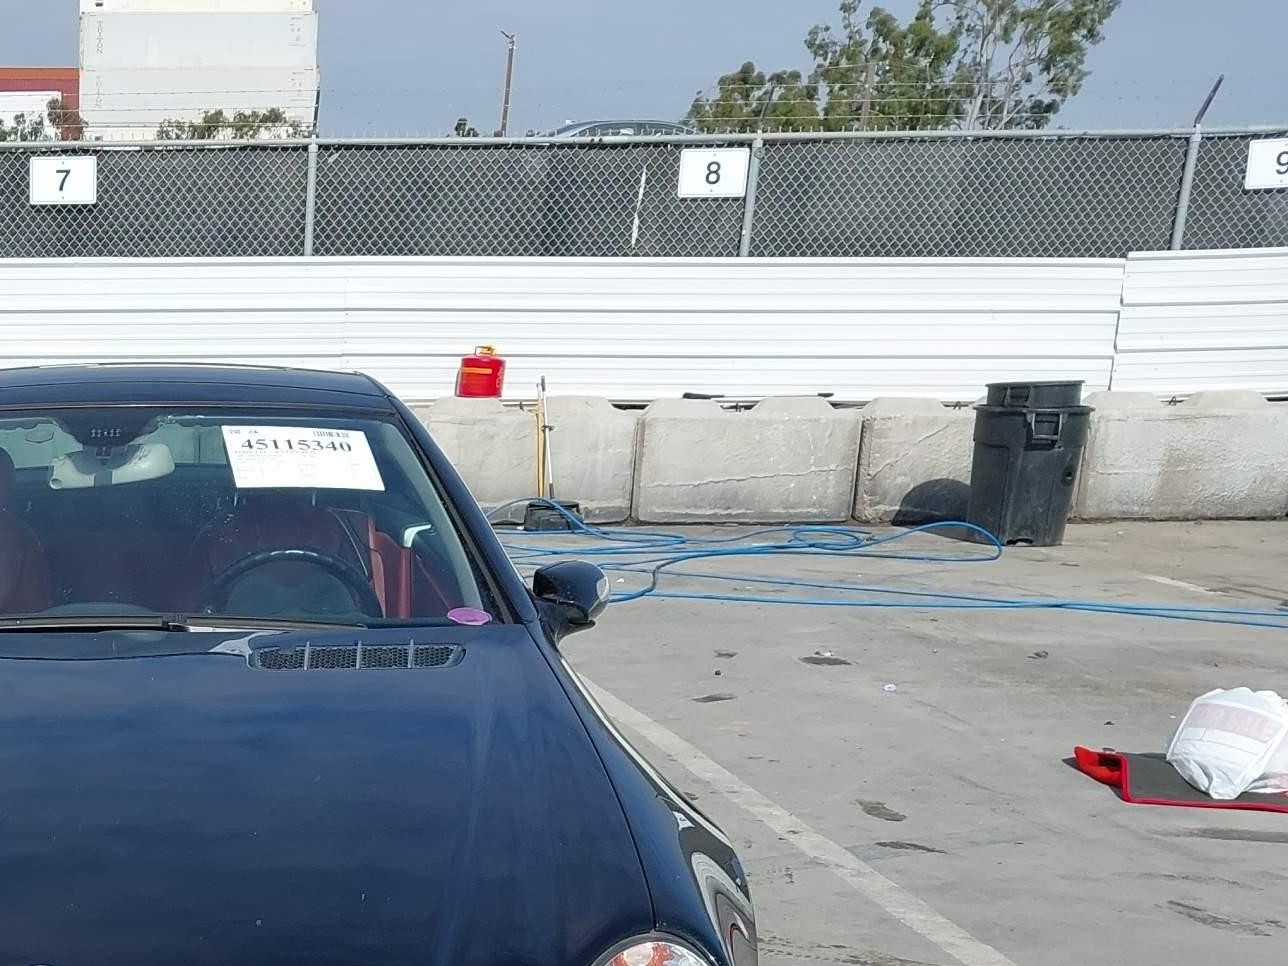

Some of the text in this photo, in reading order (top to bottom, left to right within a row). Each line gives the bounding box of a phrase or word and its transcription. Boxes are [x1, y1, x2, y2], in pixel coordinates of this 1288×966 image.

[705, 161, 721, 185] 8
[1276, 151, 1288, 175] 9
[55, 169, 71, 192] 7
[241, 438, 352, 452] 45115340
